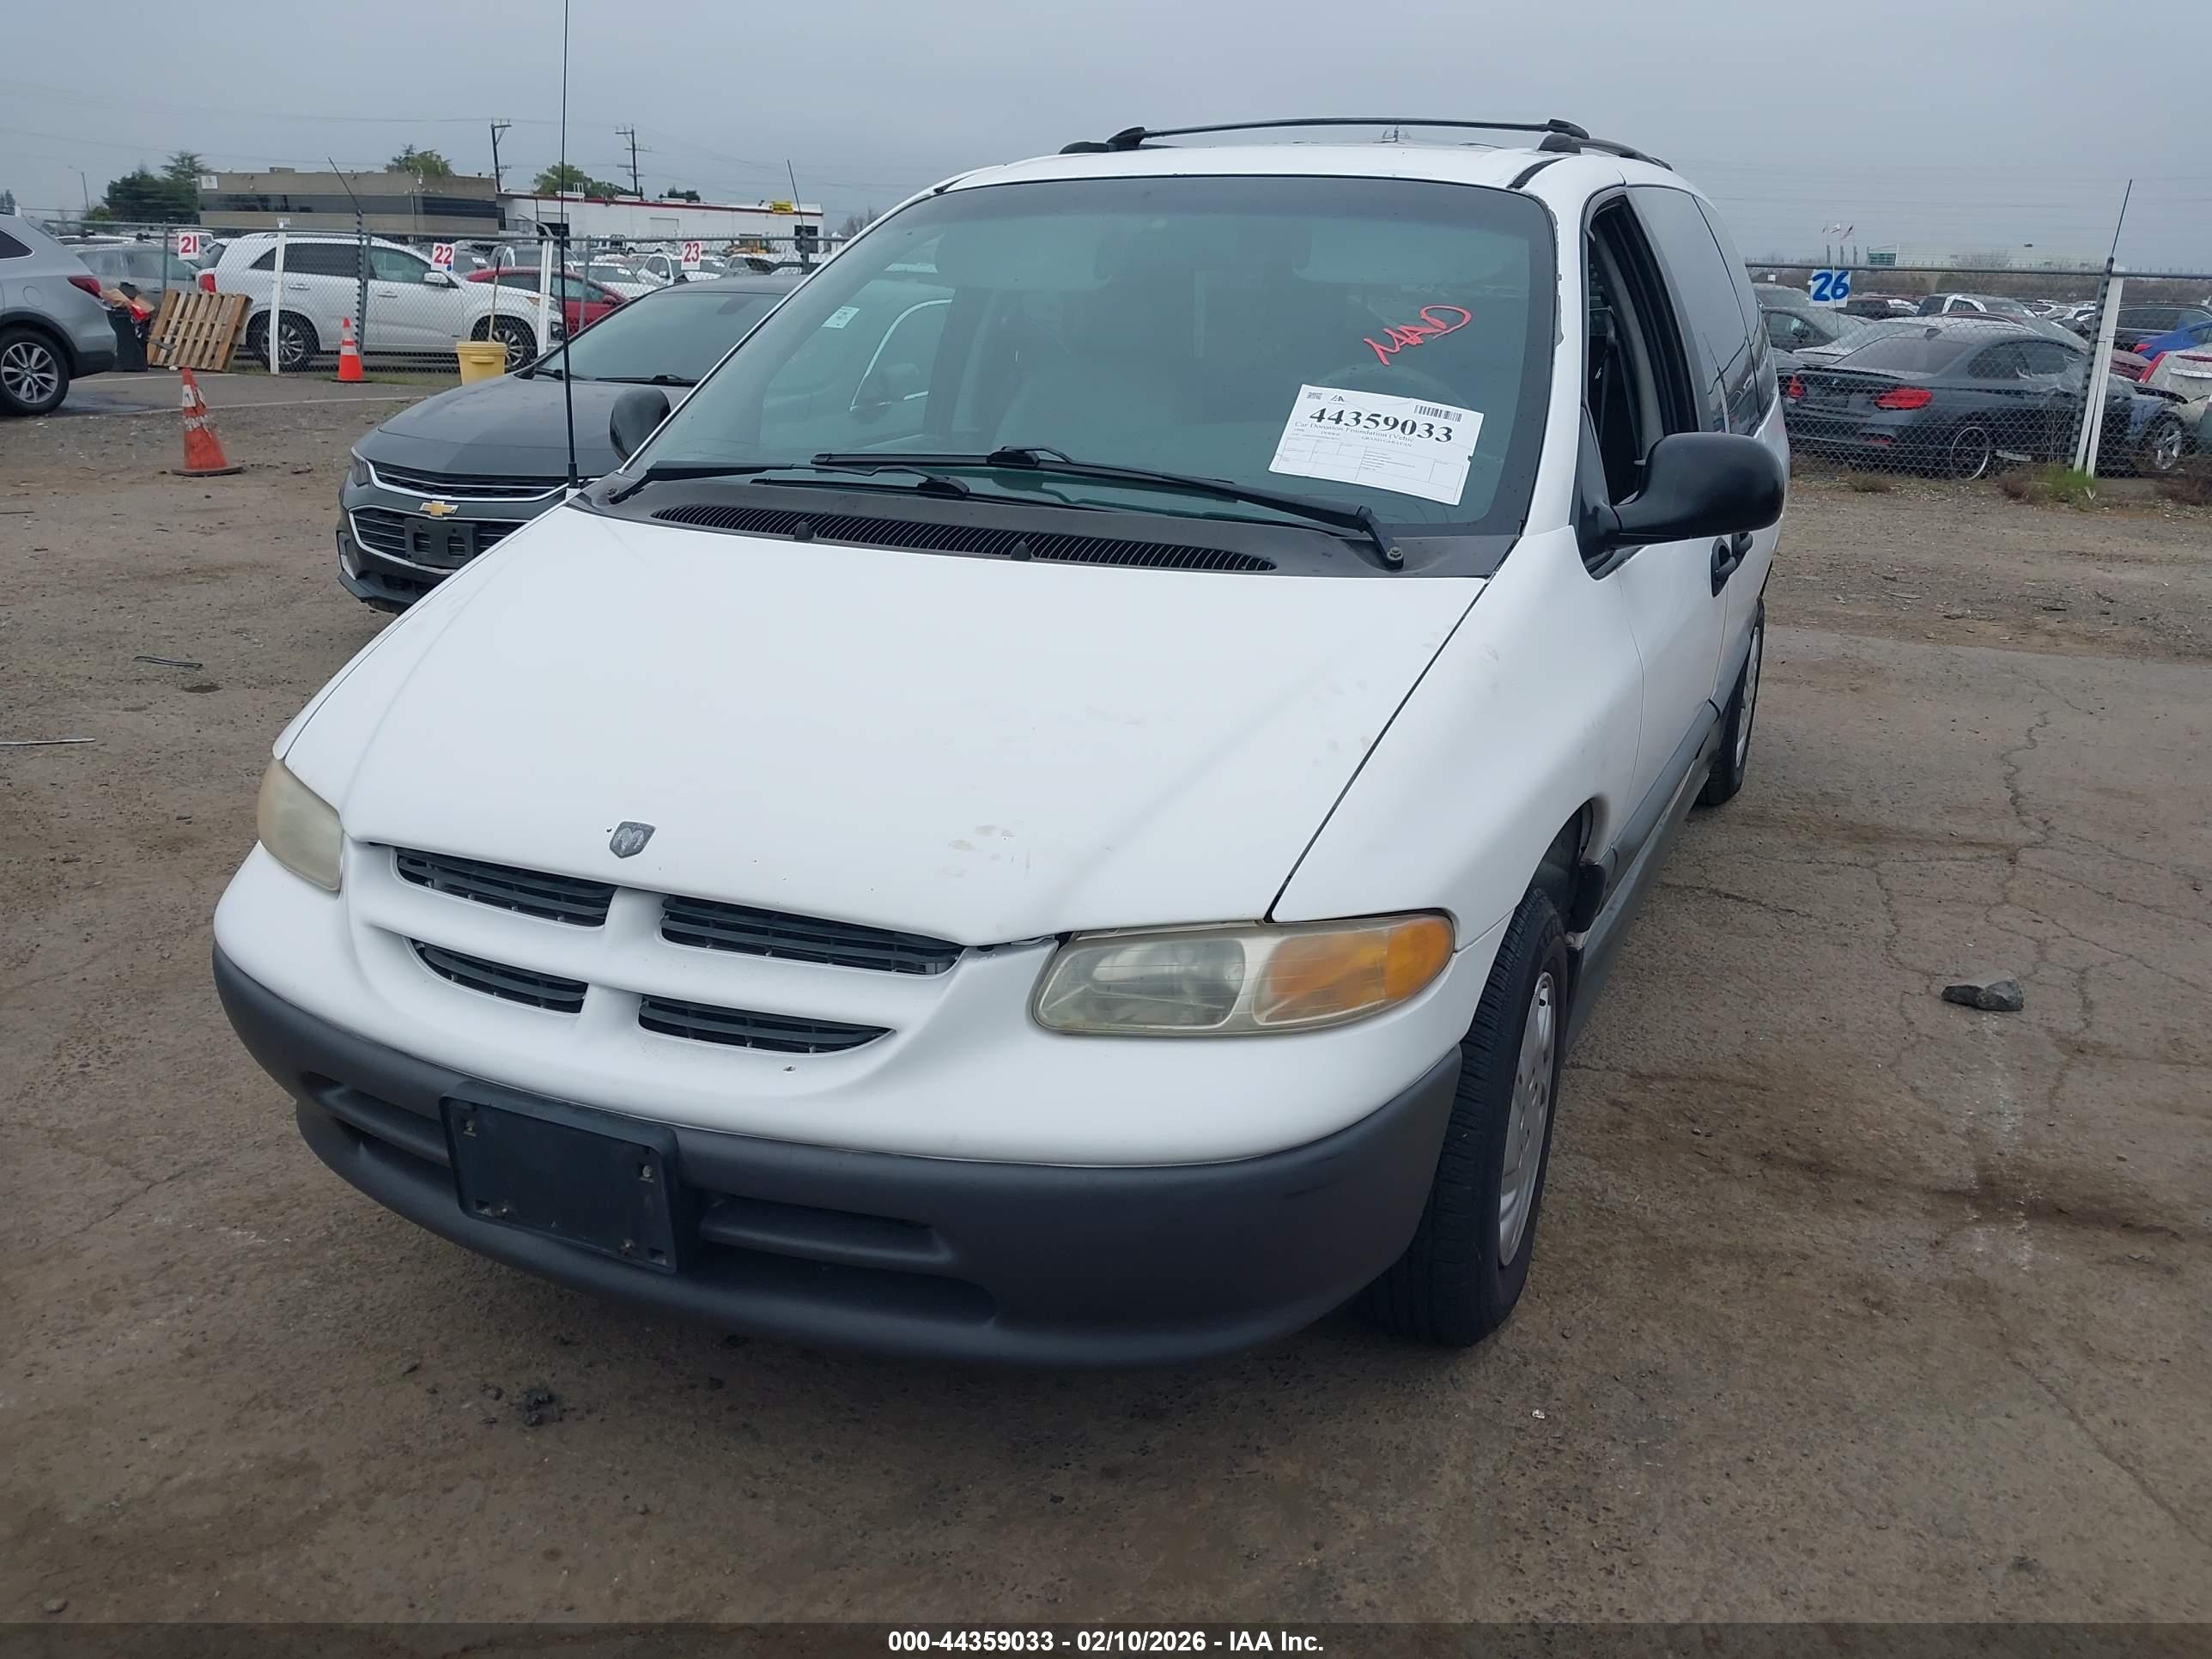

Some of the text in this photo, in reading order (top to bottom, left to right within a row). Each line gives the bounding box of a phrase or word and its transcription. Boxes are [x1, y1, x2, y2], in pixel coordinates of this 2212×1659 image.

[180, 235, 198, 253] 21
[684, 242, 700, 262] 23
[434, 246, 453, 264] 22
[1812, 270, 1850, 301] 26
[1309, 407, 1454, 443] 44359033
[1310, 422, 1344, 432] Donation
[1346, 427, 1388, 439] Foundation
